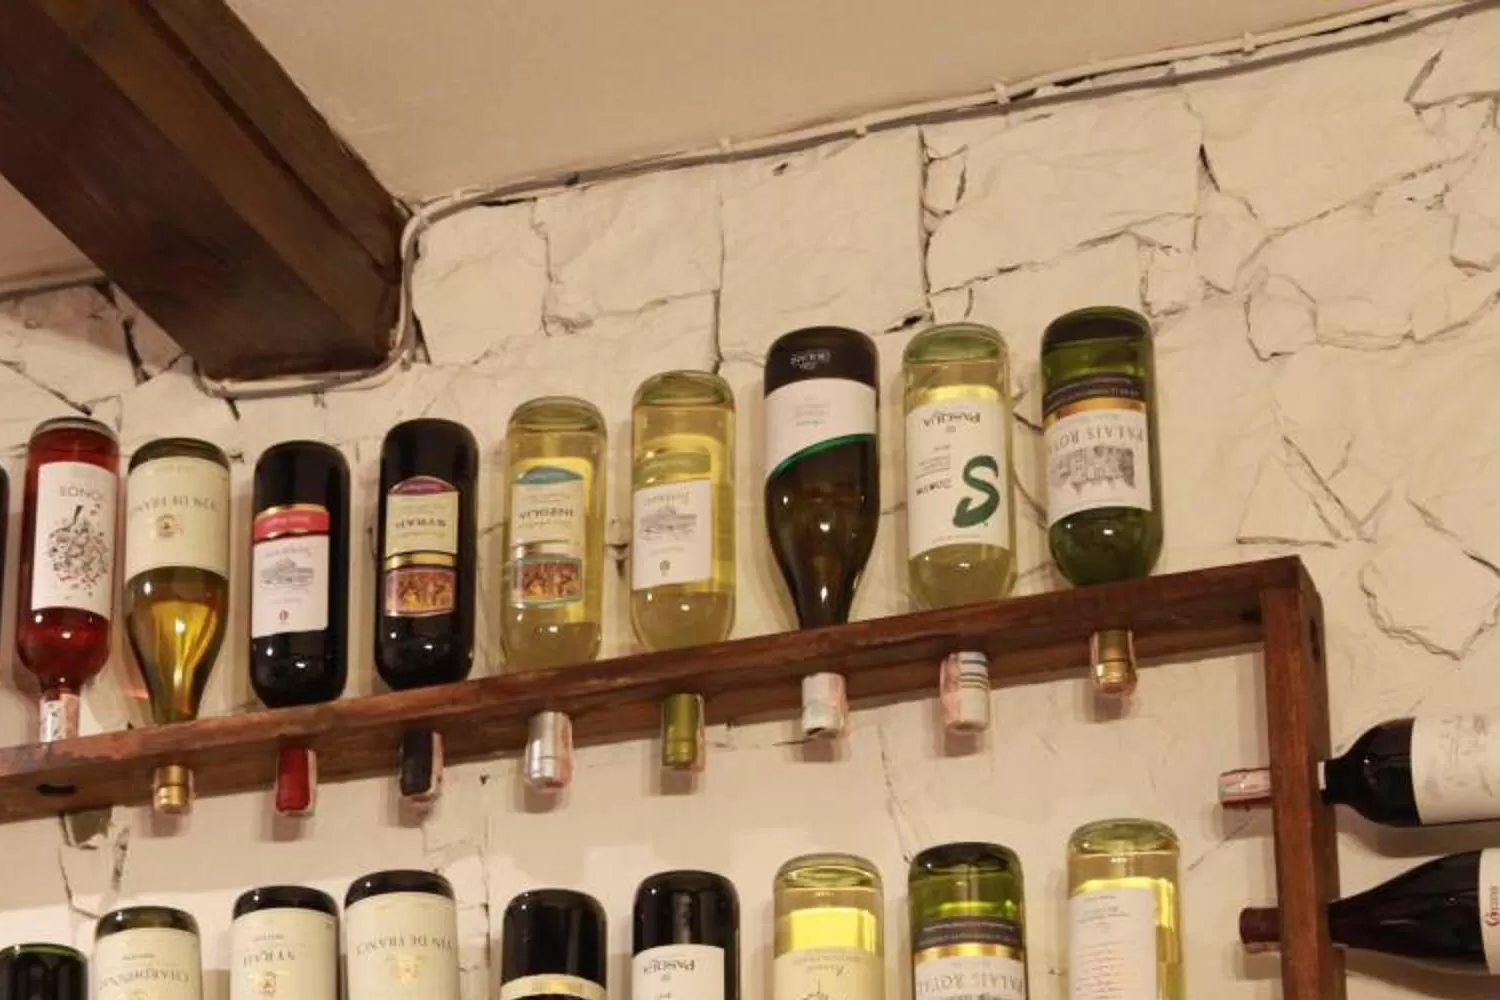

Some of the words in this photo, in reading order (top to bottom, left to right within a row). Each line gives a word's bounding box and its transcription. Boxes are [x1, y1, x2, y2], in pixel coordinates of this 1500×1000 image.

[923, 410, 981, 427] PASQUA
[1087, 425, 1144, 442] PALAIS
[953, 455, 1000, 529] S
